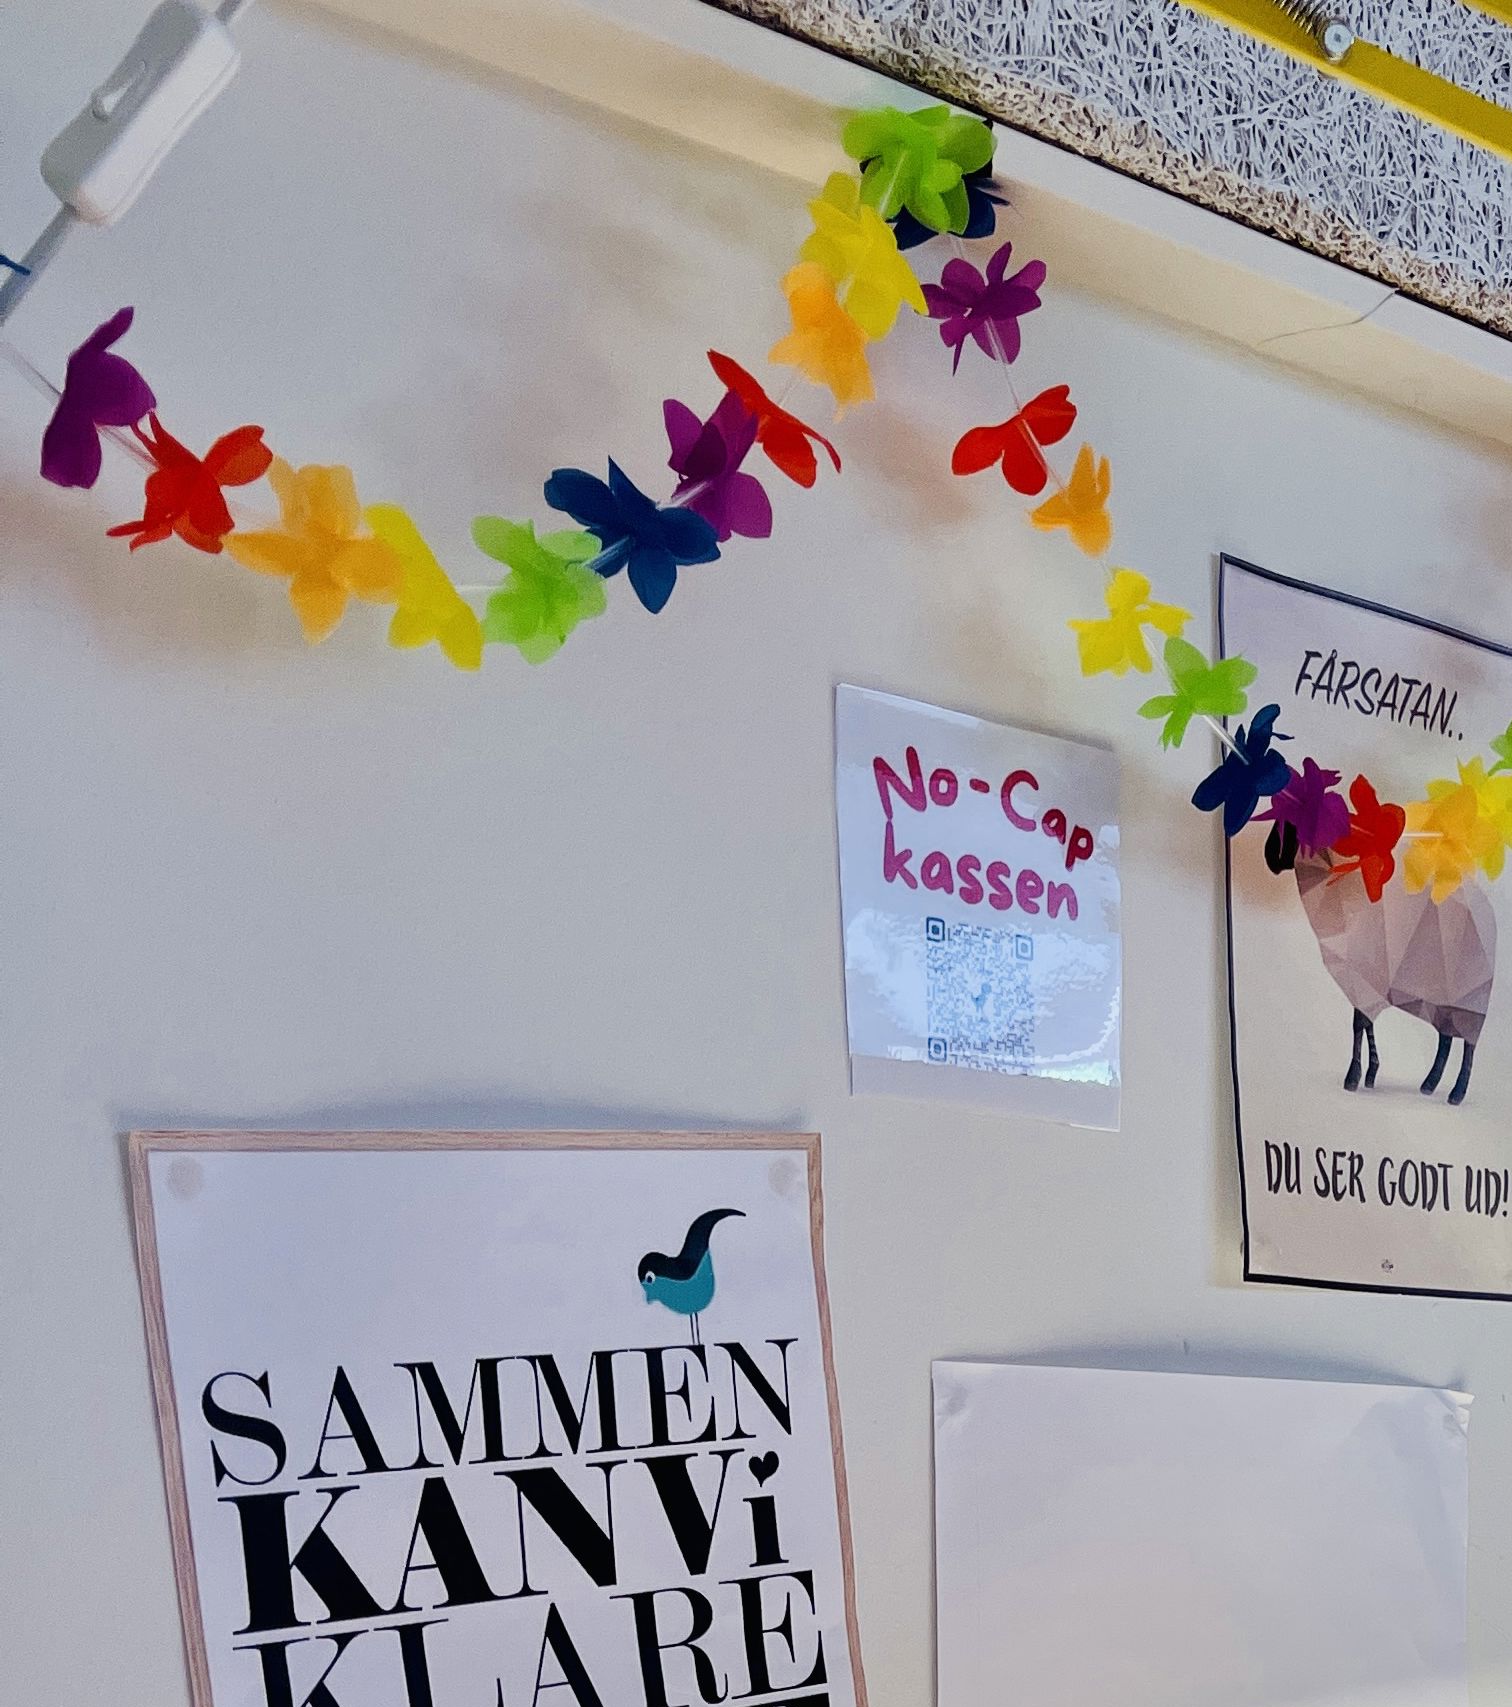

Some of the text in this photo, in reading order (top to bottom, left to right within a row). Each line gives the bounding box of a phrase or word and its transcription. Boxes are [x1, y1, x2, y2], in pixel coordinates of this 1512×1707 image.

[1294, 648, 1464, 741] FÅRSATAN..
[872, 745, 1095, 872] No-Cap
[882, 818, 1079, 921] kassen
[1264, 1139, 1510, 1218] DU SER GODT UD!
[201, 1337, 799, 1488] SAMMEN
